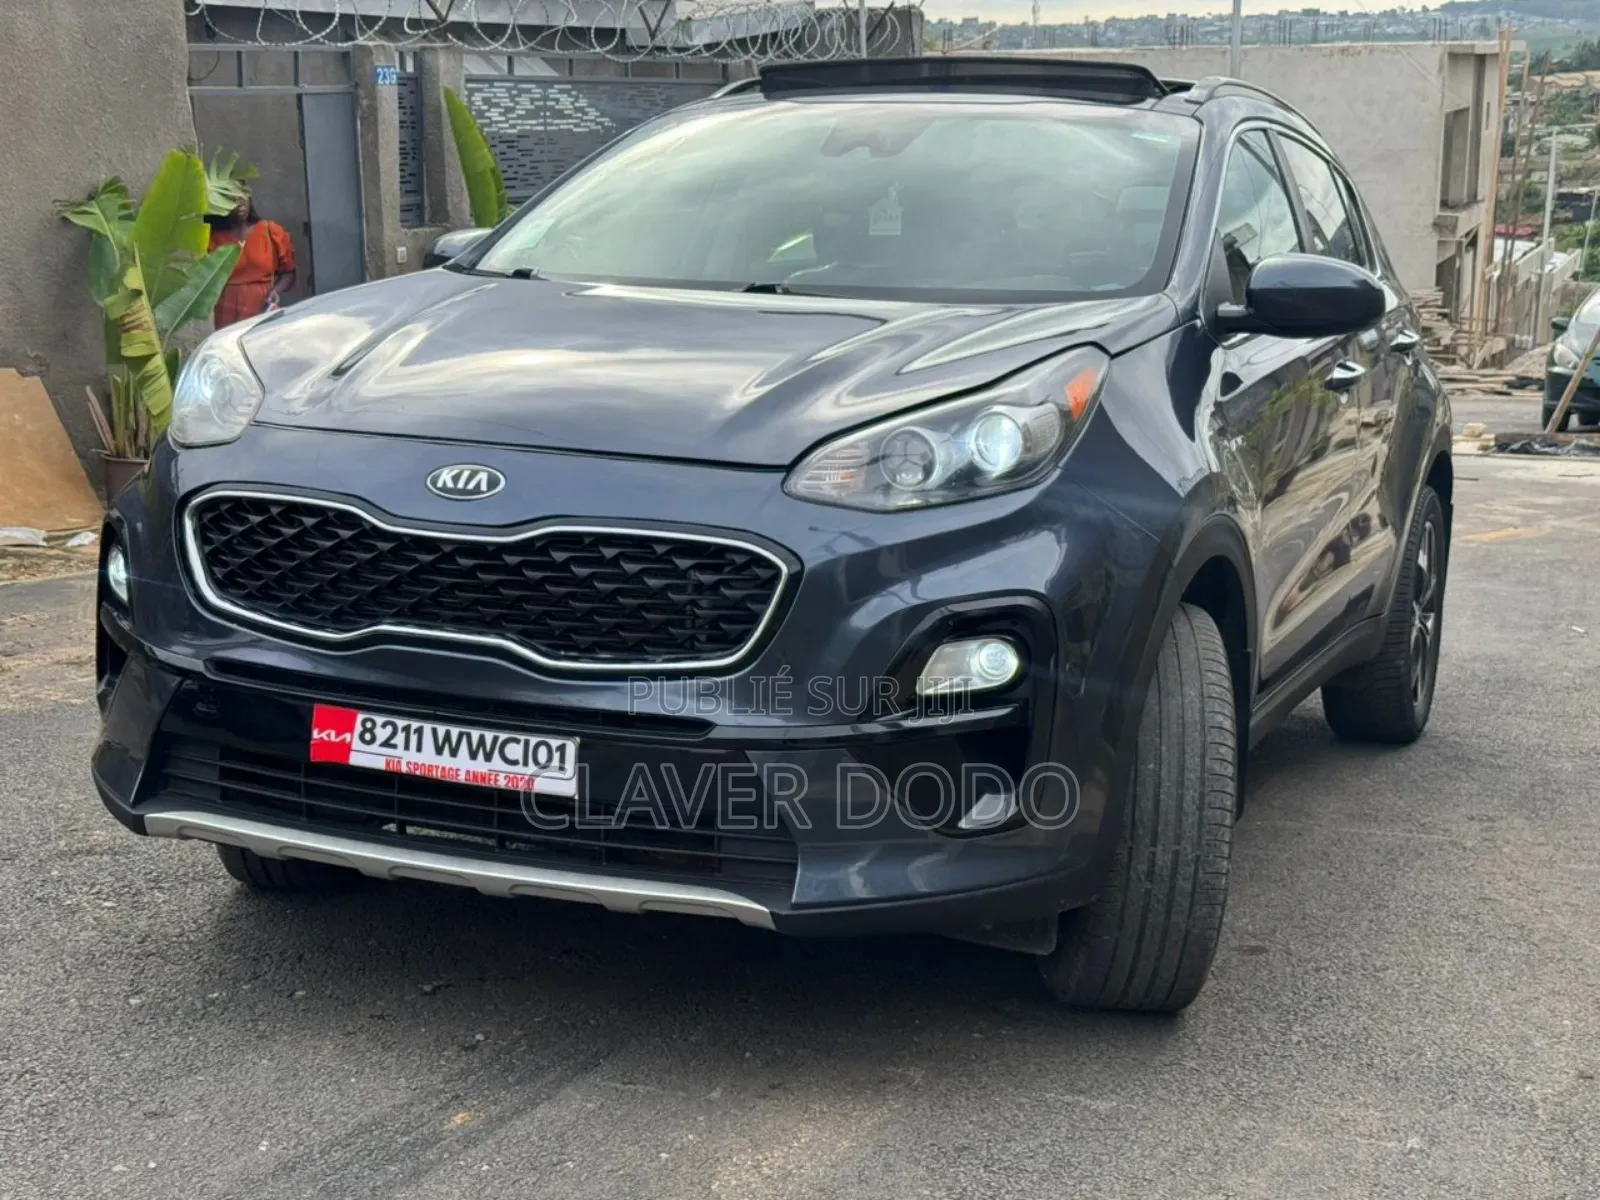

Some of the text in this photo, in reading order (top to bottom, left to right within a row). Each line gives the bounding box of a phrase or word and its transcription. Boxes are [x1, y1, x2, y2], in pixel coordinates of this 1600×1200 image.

[436, 469, 489, 492] KIA
[384, 758, 402, 773] KIA
[406, 761, 461, 781] SPORTAGE
